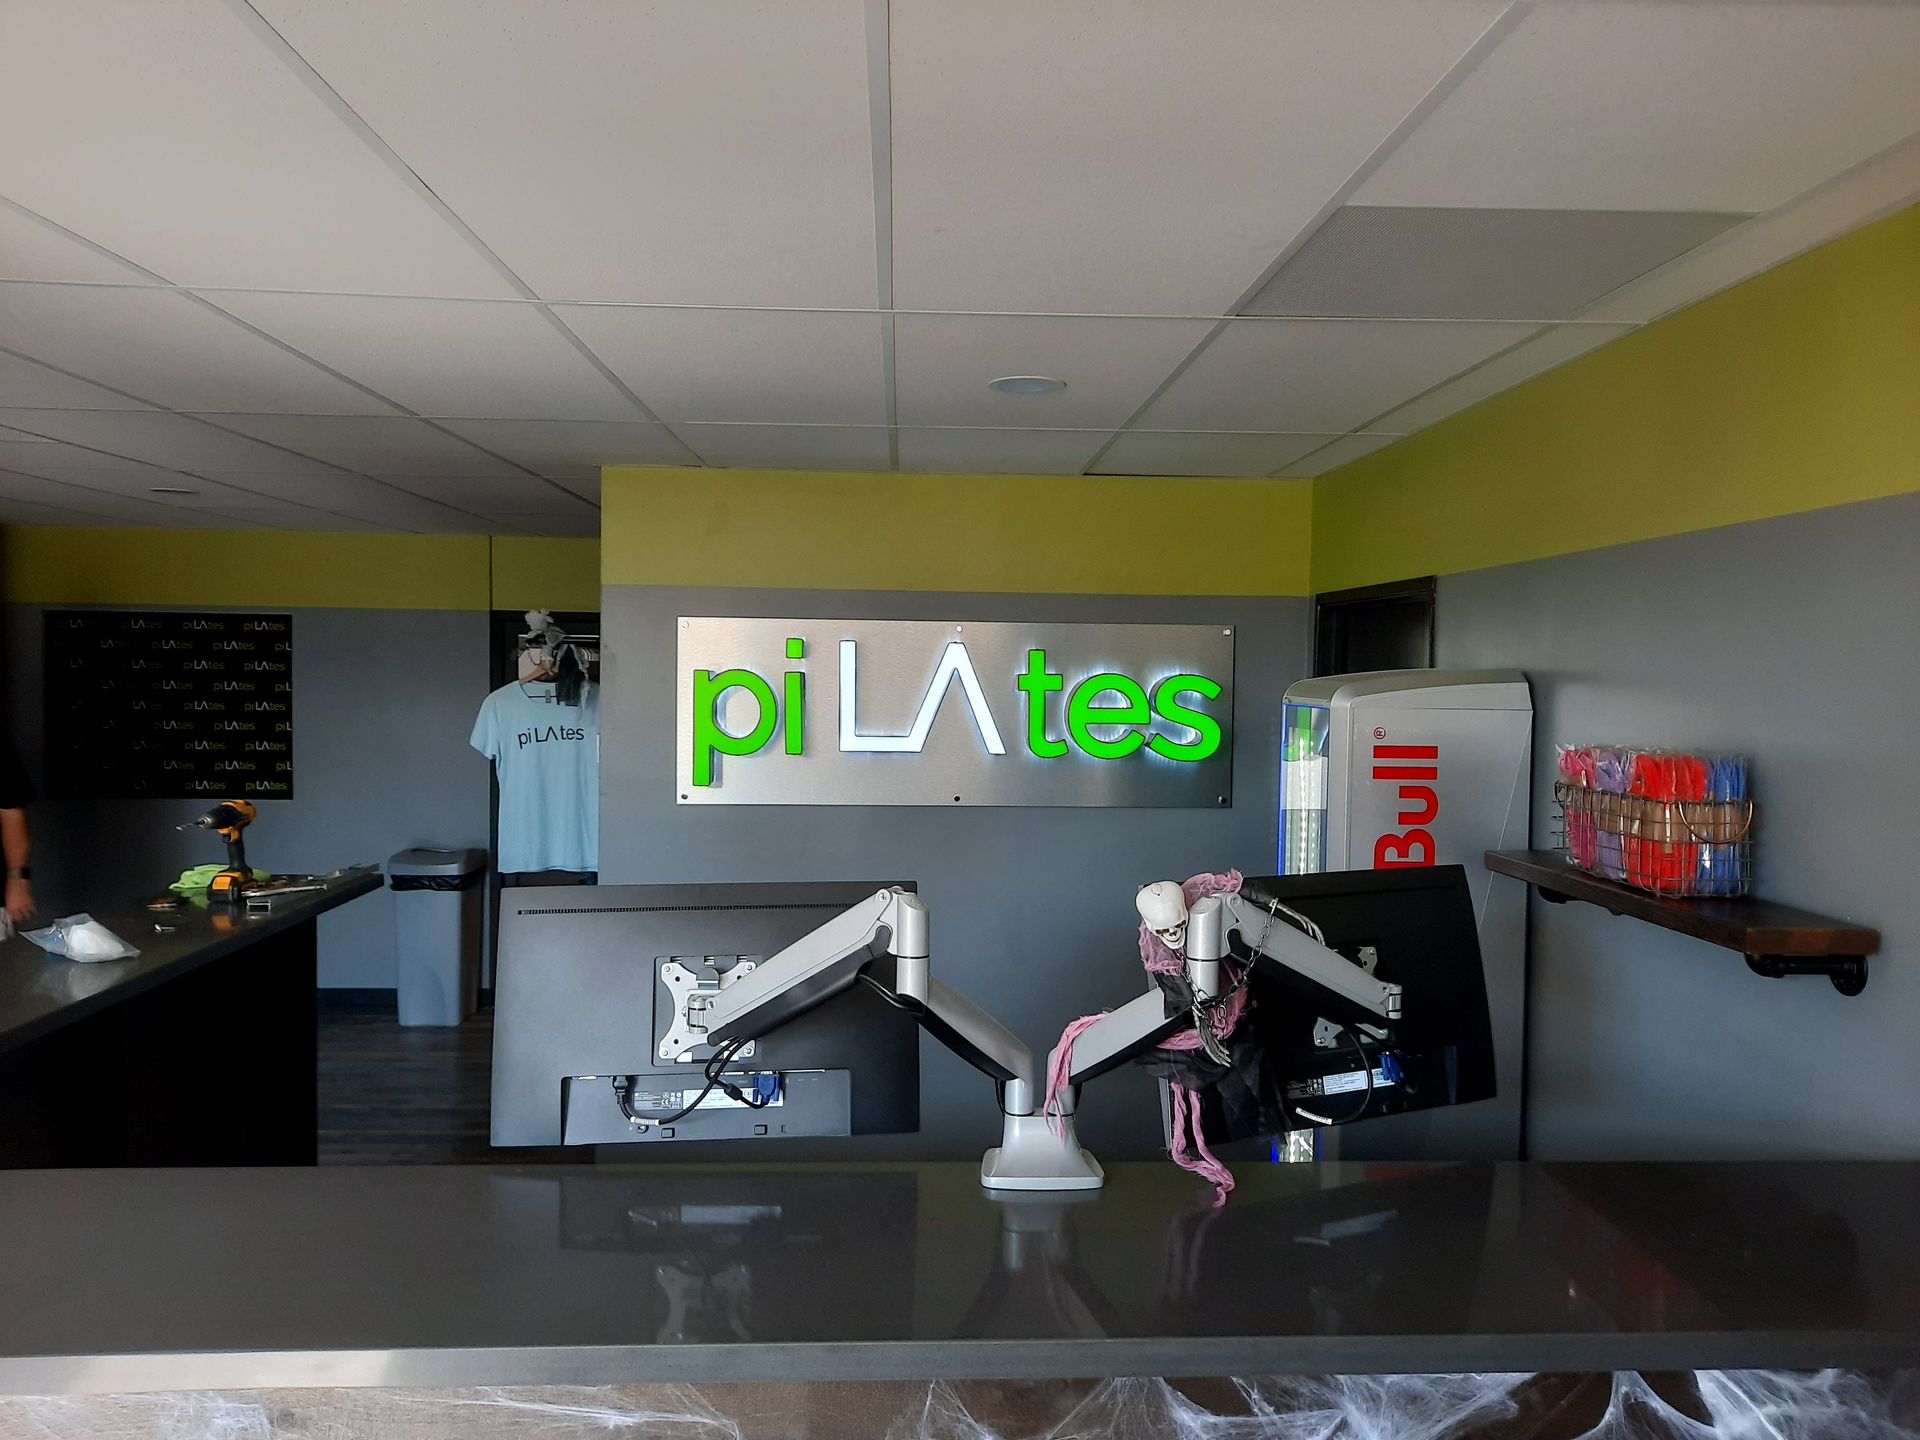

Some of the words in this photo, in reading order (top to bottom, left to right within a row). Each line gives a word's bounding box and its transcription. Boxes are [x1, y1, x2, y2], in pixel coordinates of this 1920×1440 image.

[243, 620, 287, 632] piLAtes
[212, 640, 256, 652] piLAtes
[243, 660, 287, 672] piLAtes
[213, 681, 257, 693] piLAtes
[244, 701, 287, 713] piLAtes
[693, 637, 1223, 786] piLAtes
[214, 720, 257, 732] piLAtes
[518, 725, 584, 750] piLAtes
[244, 740, 288, 752] piLAtes
[214, 760, 257, 772] piLAtes
[245, 780, 289, 792] piLAtes
